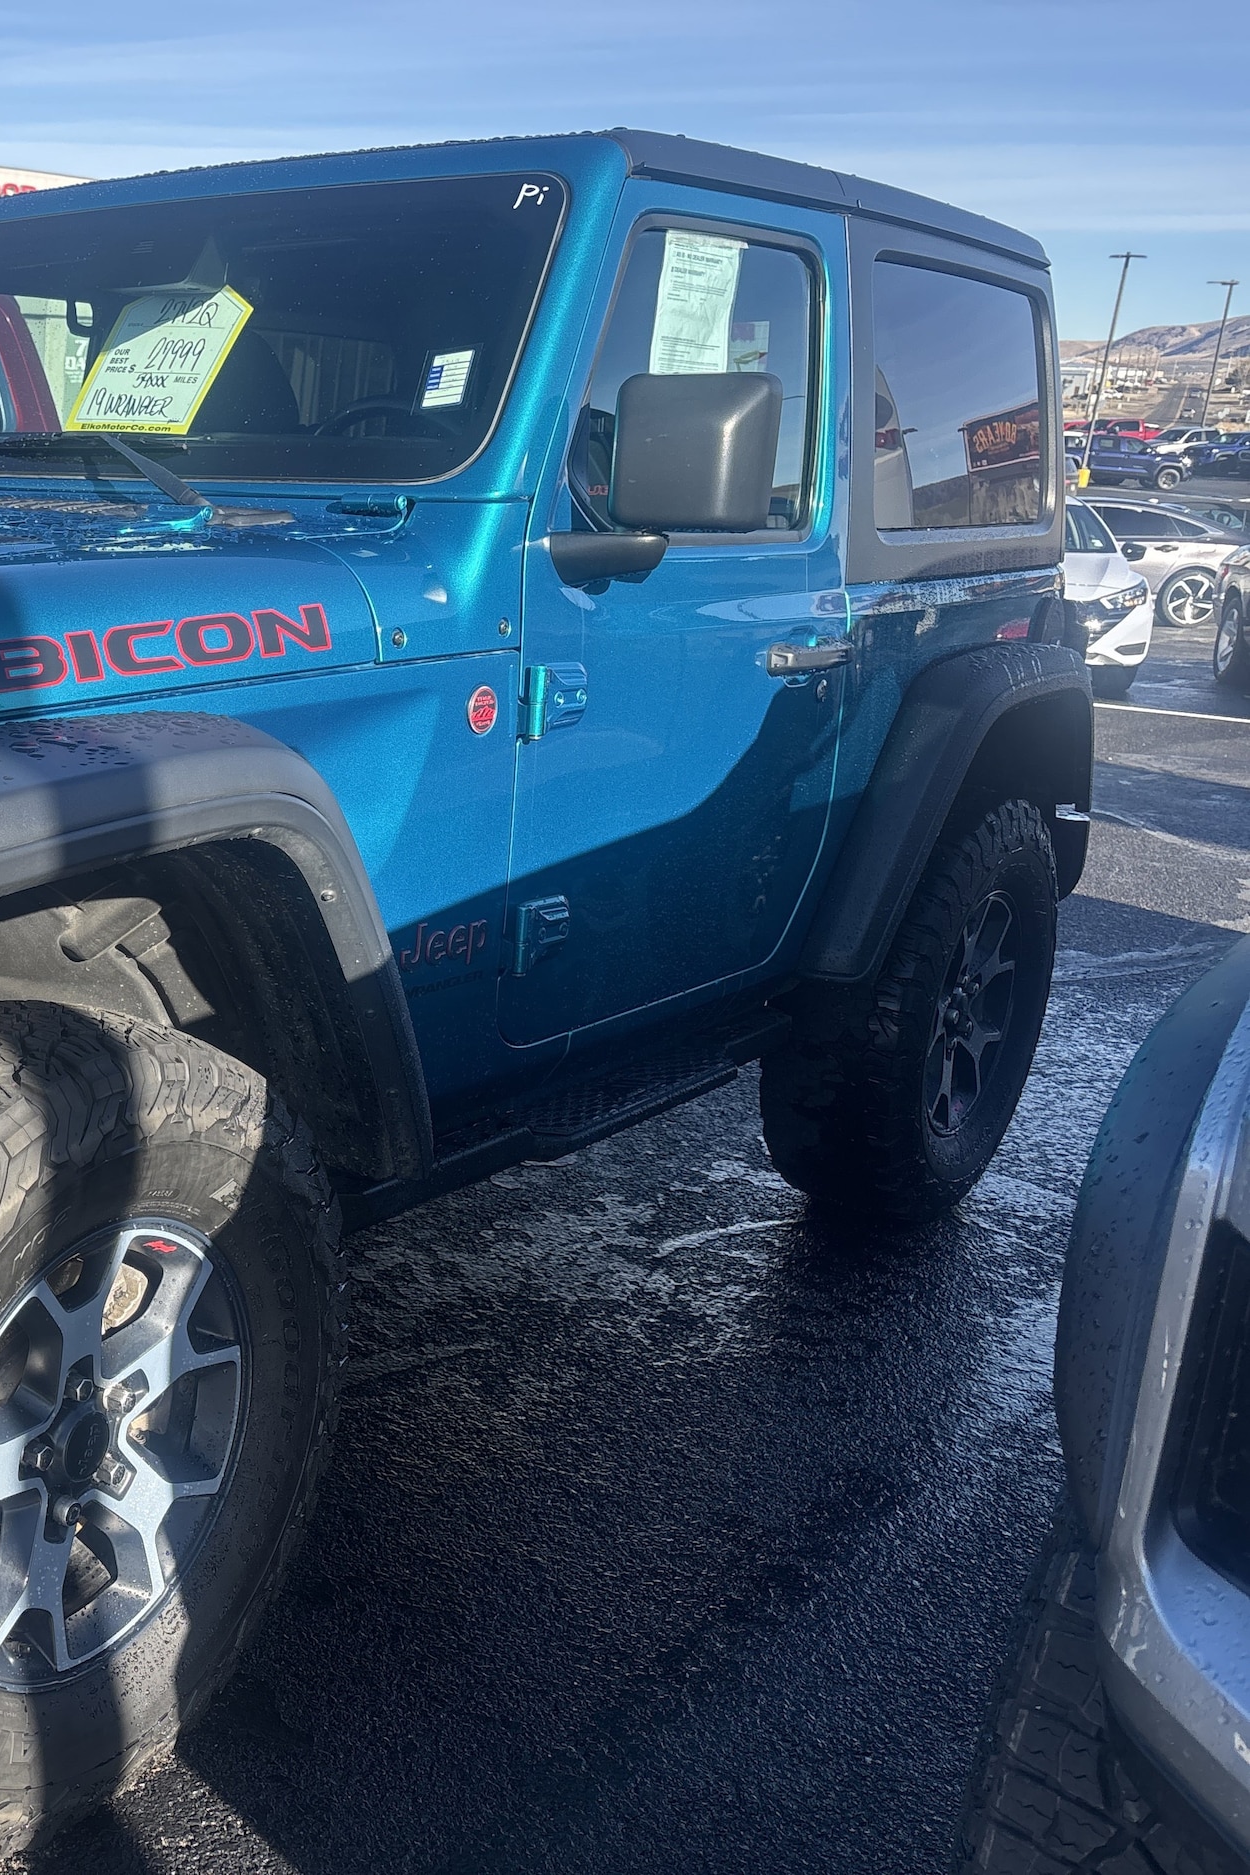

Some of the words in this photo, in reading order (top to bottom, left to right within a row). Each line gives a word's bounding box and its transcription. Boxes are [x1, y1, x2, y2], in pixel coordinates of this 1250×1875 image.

[114, 348, 131, 356] OUR
[143, 336, 206, 372] 27999
[173, 376, 199, 384] MILES
[86, 387, 108, 416] 19
[103, 393, 174, 418] WRANGLER
[80, 423, 172, 432] ElkoMotorCo.com
[400, 918, 488, 973] Jeep
